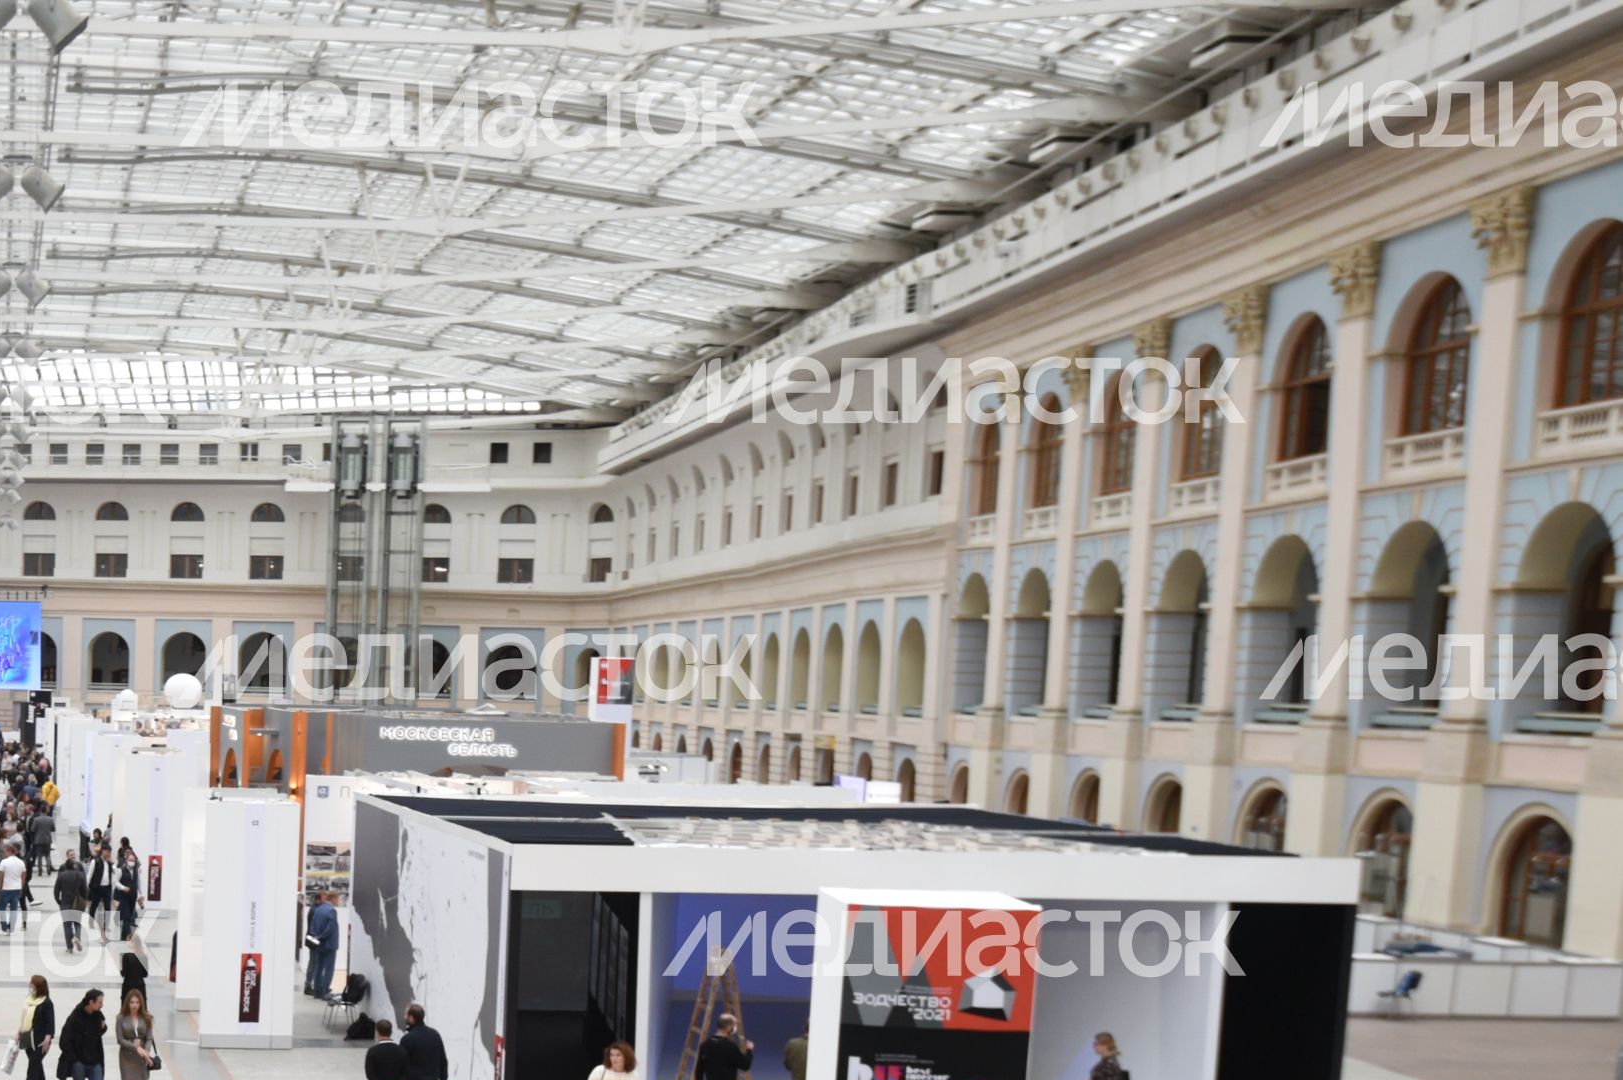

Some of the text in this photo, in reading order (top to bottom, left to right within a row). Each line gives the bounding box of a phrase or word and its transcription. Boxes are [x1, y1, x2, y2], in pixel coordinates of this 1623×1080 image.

[379, 726, 494, 741] МОСКОВСКАЯ
[448, 743, 518, 757] ОБЛАСТЬ
[852, 992, 952, 1009] ЗОДЧЕСТВО
